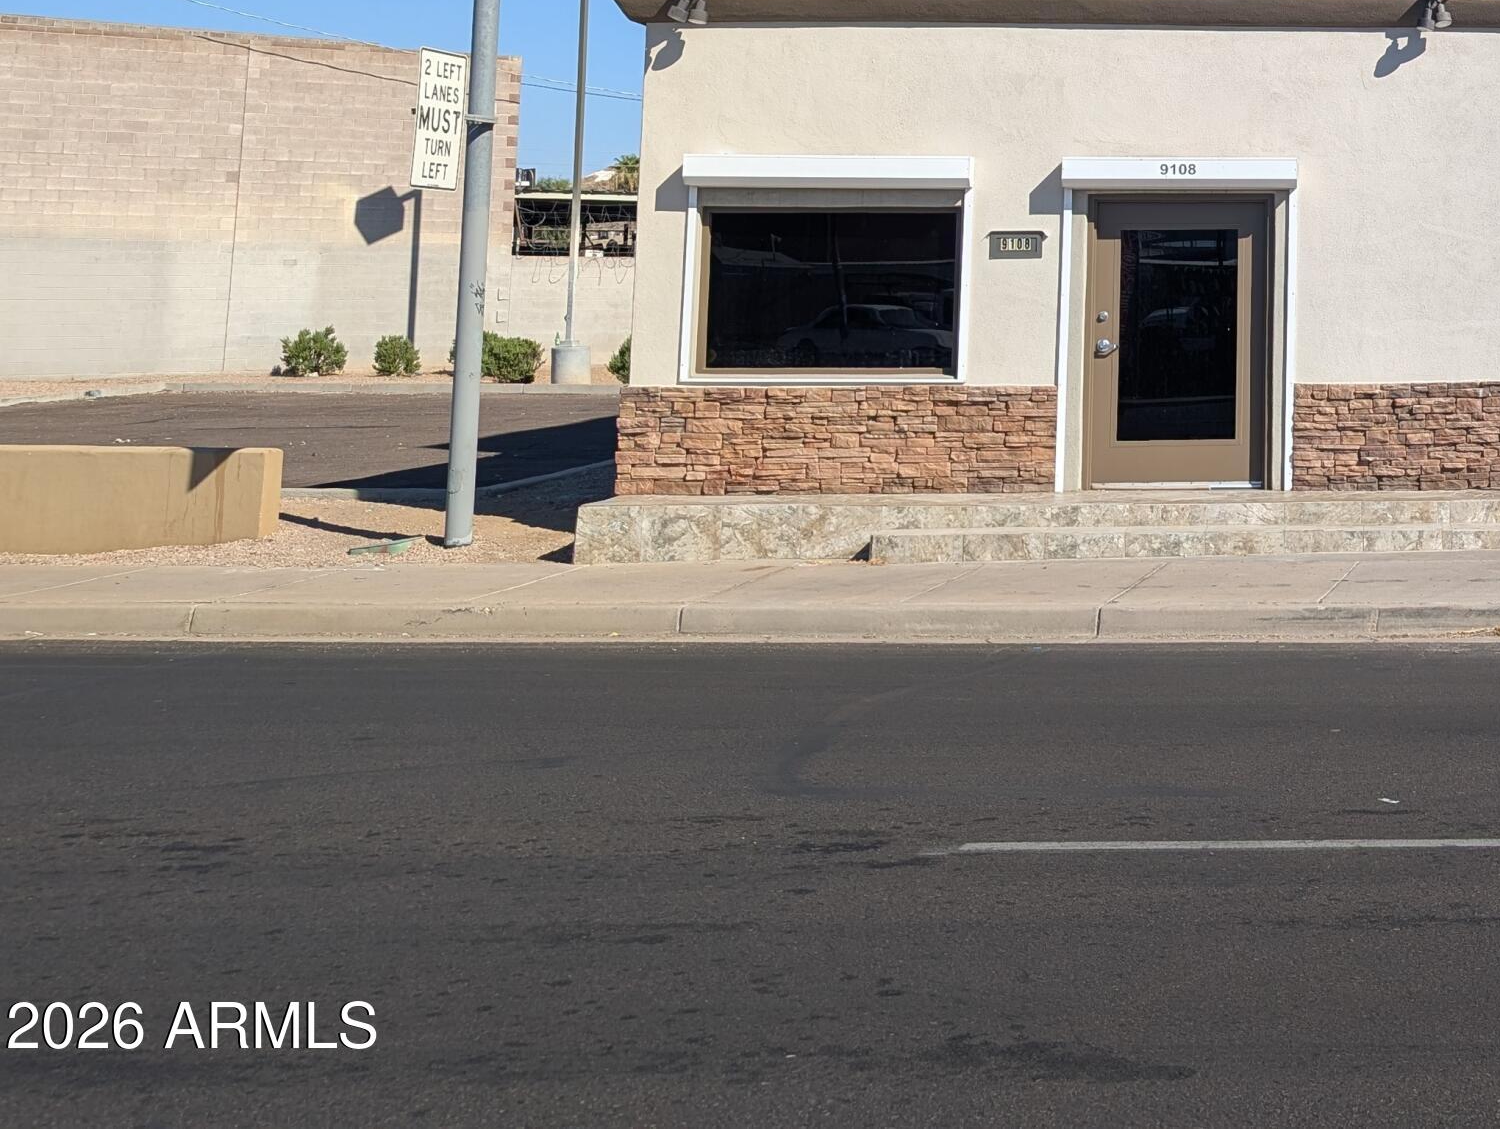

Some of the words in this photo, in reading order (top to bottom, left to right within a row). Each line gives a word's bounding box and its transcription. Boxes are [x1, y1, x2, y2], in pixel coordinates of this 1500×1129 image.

[424, 58, 432, 76] 2
[436, 60, 462, 82] LEFT
[424, 82, 459, 104] LANES
[418, 105, 461, 135] MUST
[424, 137, 452, 157] TURN
[421, 161, 449, 181] LEFT
[1160, 163, 1197, 176] 9108
[1002, 238, 1030, 250] 9108
